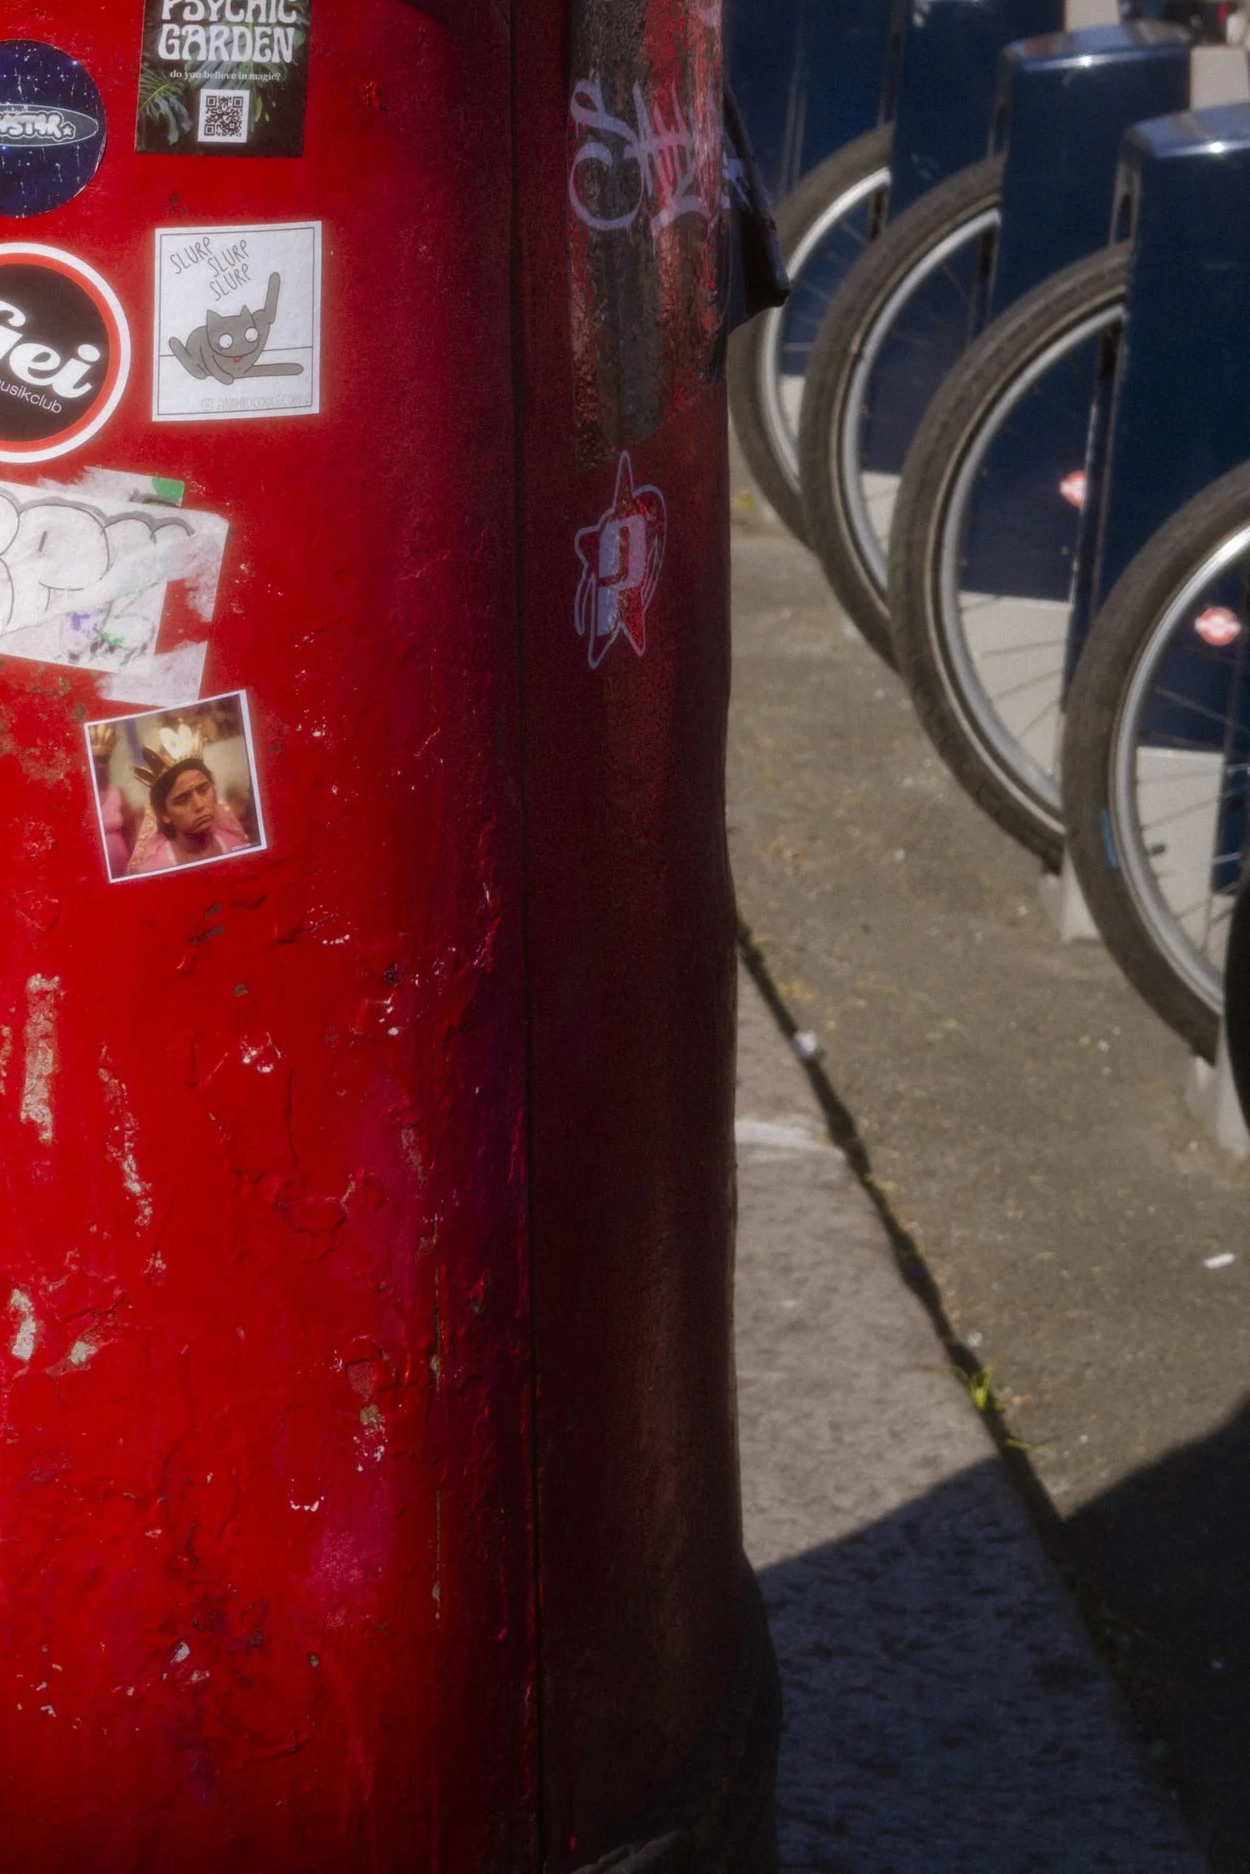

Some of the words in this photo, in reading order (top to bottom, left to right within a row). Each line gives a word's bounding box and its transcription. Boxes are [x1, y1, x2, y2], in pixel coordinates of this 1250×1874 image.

[158, 23, 295, 63] GARDEN
[170, 70, 182, 78] do
[184, 71, 202, 80] you
[203, 70, 236, 80] believe
[238, 71, 248, 80] in
[249, 72, 281, 82] magic?
[170, 236, 213, 274] SLURP
[207, 239, 250, 278] SLURP
[209, 263, 251, 302] SLURP
